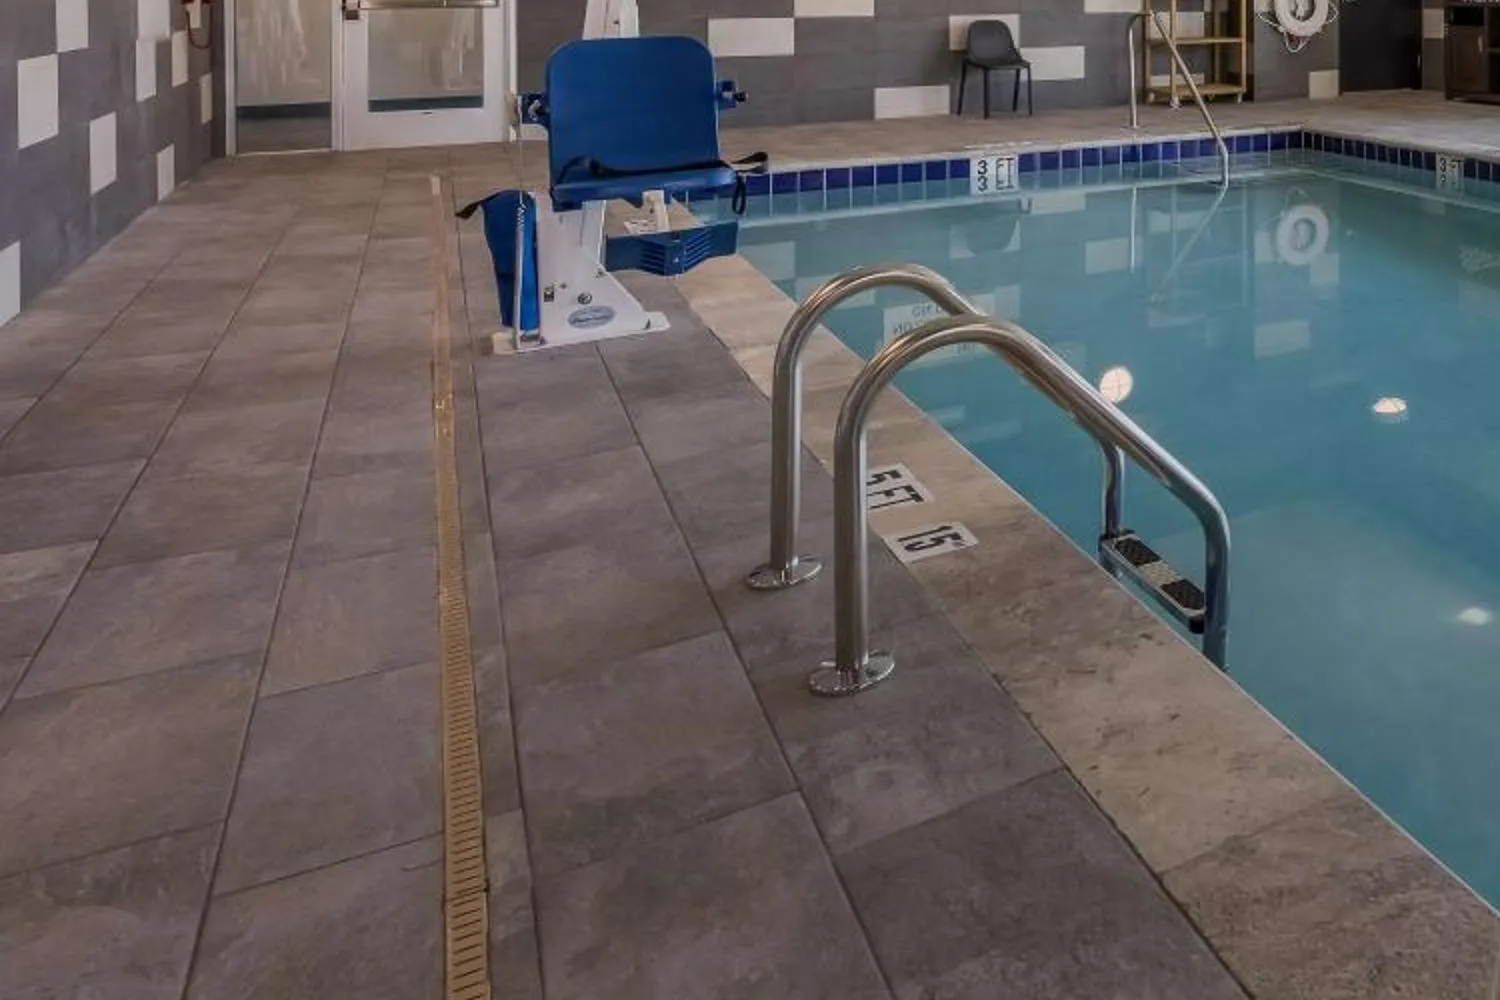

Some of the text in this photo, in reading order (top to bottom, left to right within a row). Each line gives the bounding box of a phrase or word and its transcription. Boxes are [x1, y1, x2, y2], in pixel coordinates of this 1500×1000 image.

[978, 157, 1015, 175] 3 FT
[1440, 157, 1447, 172] 3
